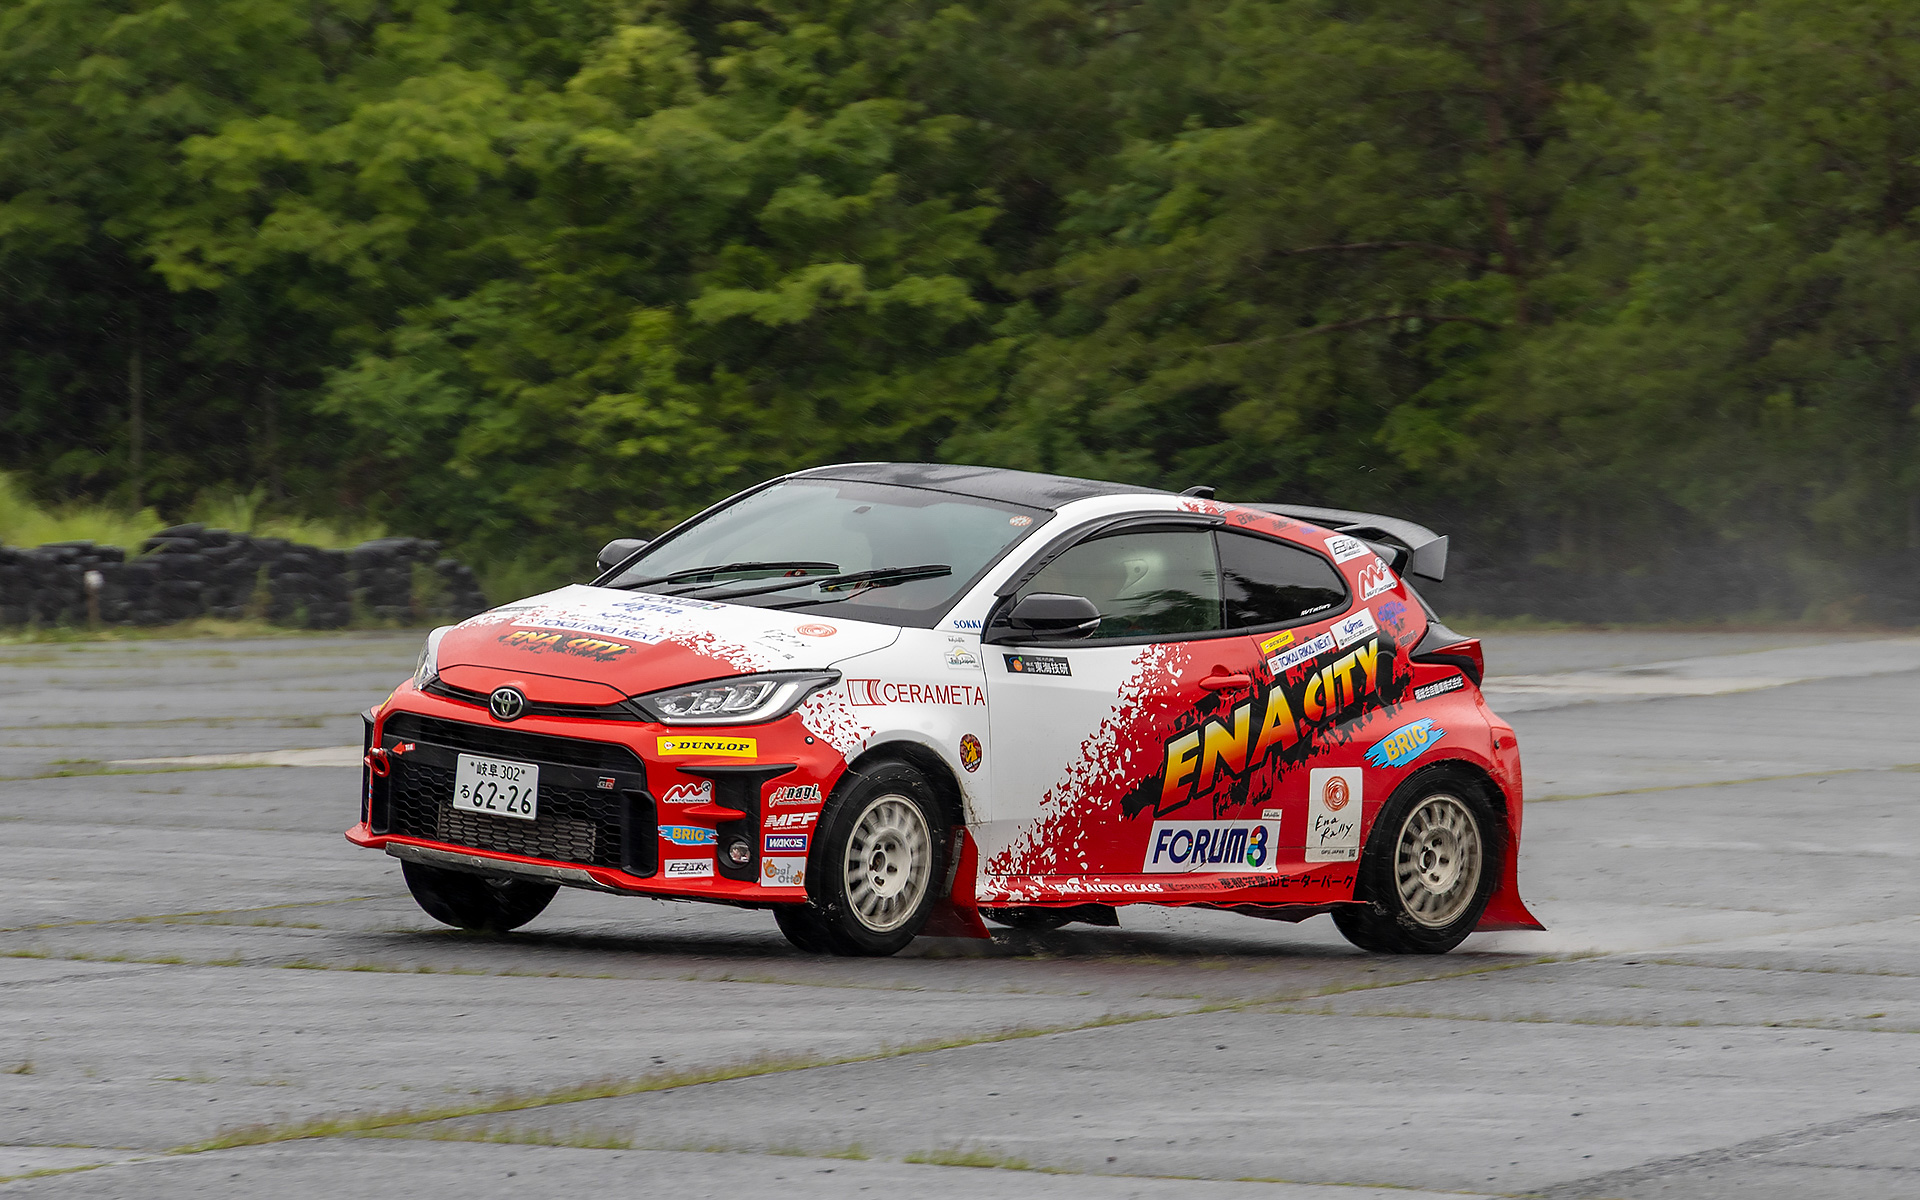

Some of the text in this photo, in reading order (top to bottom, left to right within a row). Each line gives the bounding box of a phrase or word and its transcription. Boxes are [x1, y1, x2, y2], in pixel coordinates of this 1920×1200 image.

[505, 630, 632, 655] ENA CITY
[618, 629, 663, 641] NEXT
[1269, 635, 1289, 648] DUNLOP
[1278, 651, 1298, 667] TOKAI
[1298, 644, 1315, 659] RIKA
[1313, 635, 1332, 651] NEXT
[883, 682, 986, 706] CERAMETA
[1157, 637, 1378, 813] ENA CITY
[677, 741, 750, 752] DUNLOP
[1383, 724, 1429, 763] BRIG
[476, 763, 521, 782] 岐阜 302
[473, 780, 533, 814] 62-26
[764, 812, 819, 827] MFF
[1315, 814, 1340, 831] Ena
[672, 828, 706, 841] BRIG
[1321, 824, 1353, 846] Rally
[1152, 825, 1268, 869] FORUM8
[1084, 883, 1123, 893] AUTO
[1124, 883, 1164, 893] GLASS
